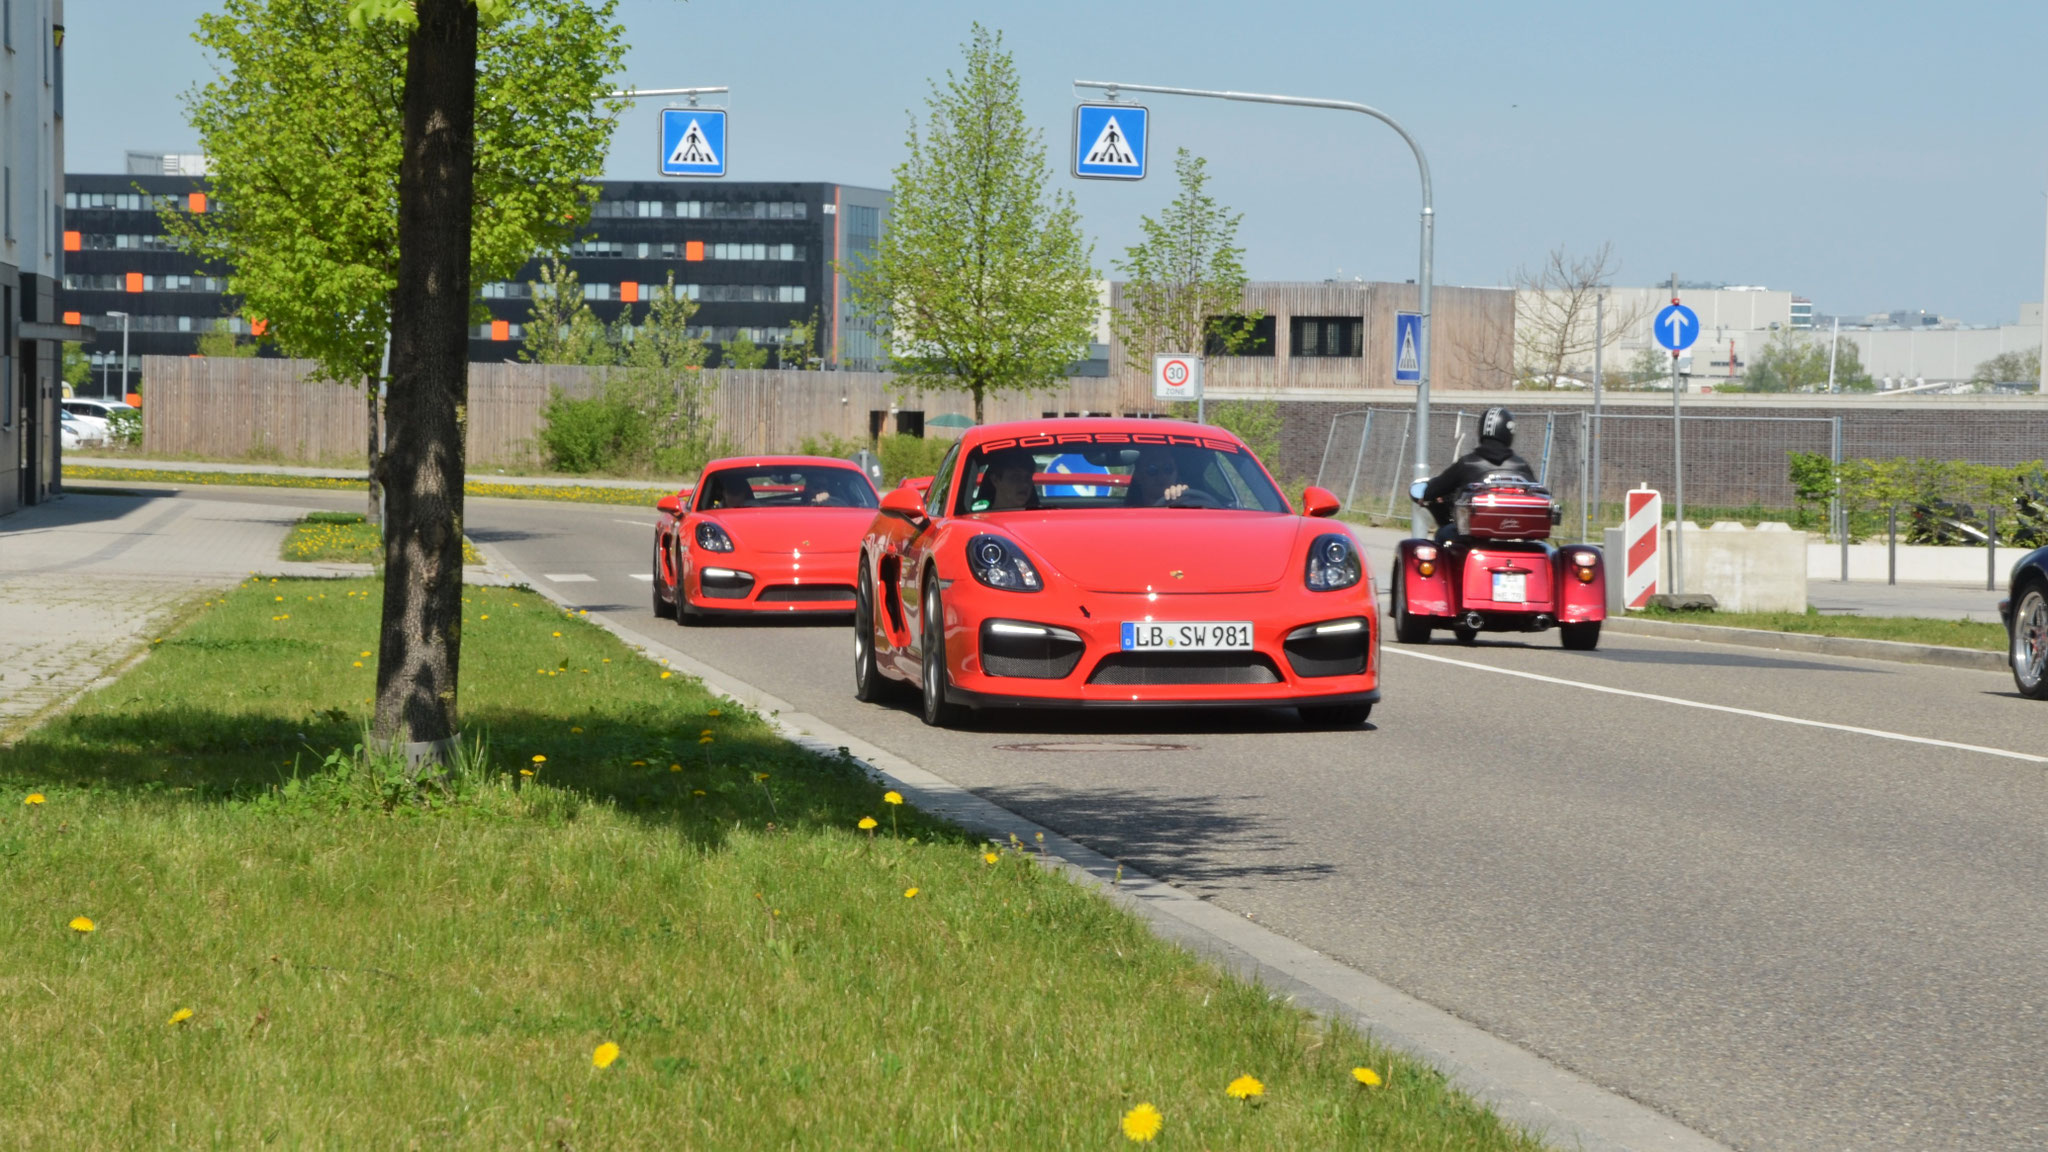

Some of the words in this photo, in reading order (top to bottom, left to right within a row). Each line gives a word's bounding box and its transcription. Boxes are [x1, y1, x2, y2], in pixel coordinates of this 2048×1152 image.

[1168, 367, 1184, 380] 30
[981, 433, 1239, 454] PORSCHE
[1136, 626, 1163, 647] LB
[1179, 626, 1206, 647] SW
[1212, 626, 1250, 647] 981
